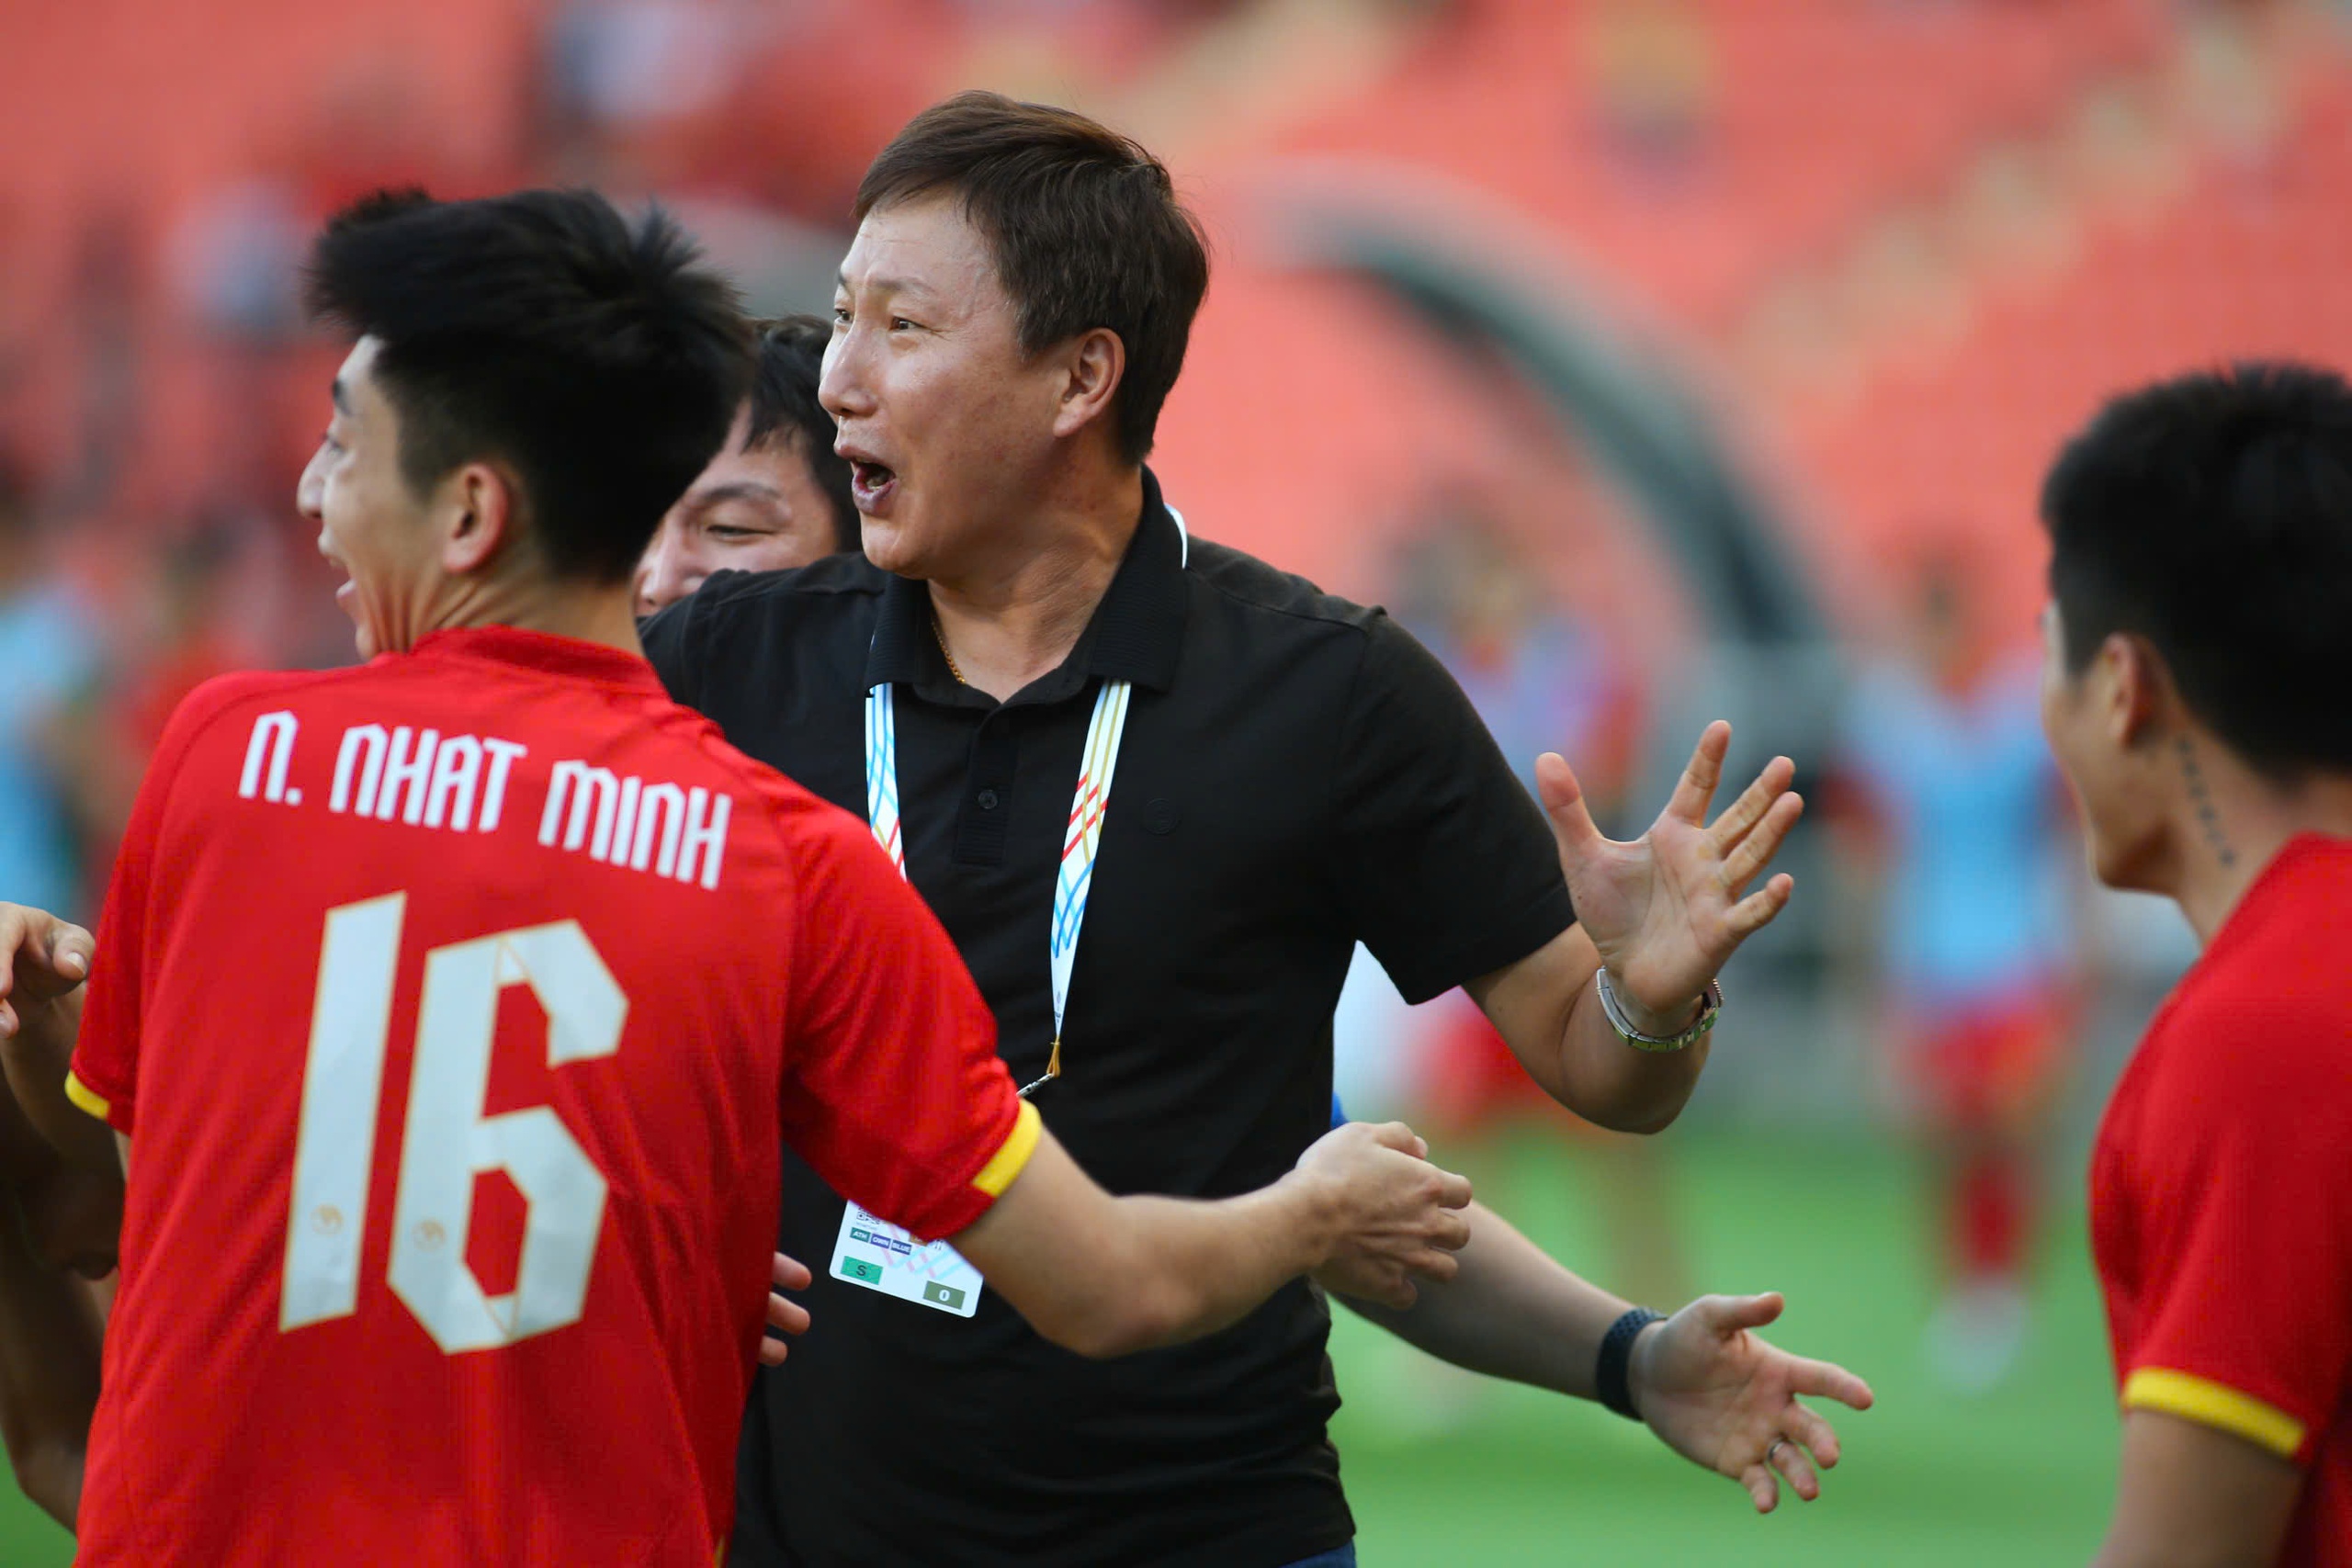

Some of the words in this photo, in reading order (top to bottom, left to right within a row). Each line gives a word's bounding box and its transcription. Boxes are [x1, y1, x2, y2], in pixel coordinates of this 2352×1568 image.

[238, 710, 301, 805] N.
[329, 724, 528, 831] NHAT
[537, 759, 731, 890] MINH
[279, 891, 628, 1353] 16
[855, 1264, 866, 1277] S
[872, 1235, 889, 1247] OWN
[892, 1242, 911, 1254] BLUE
